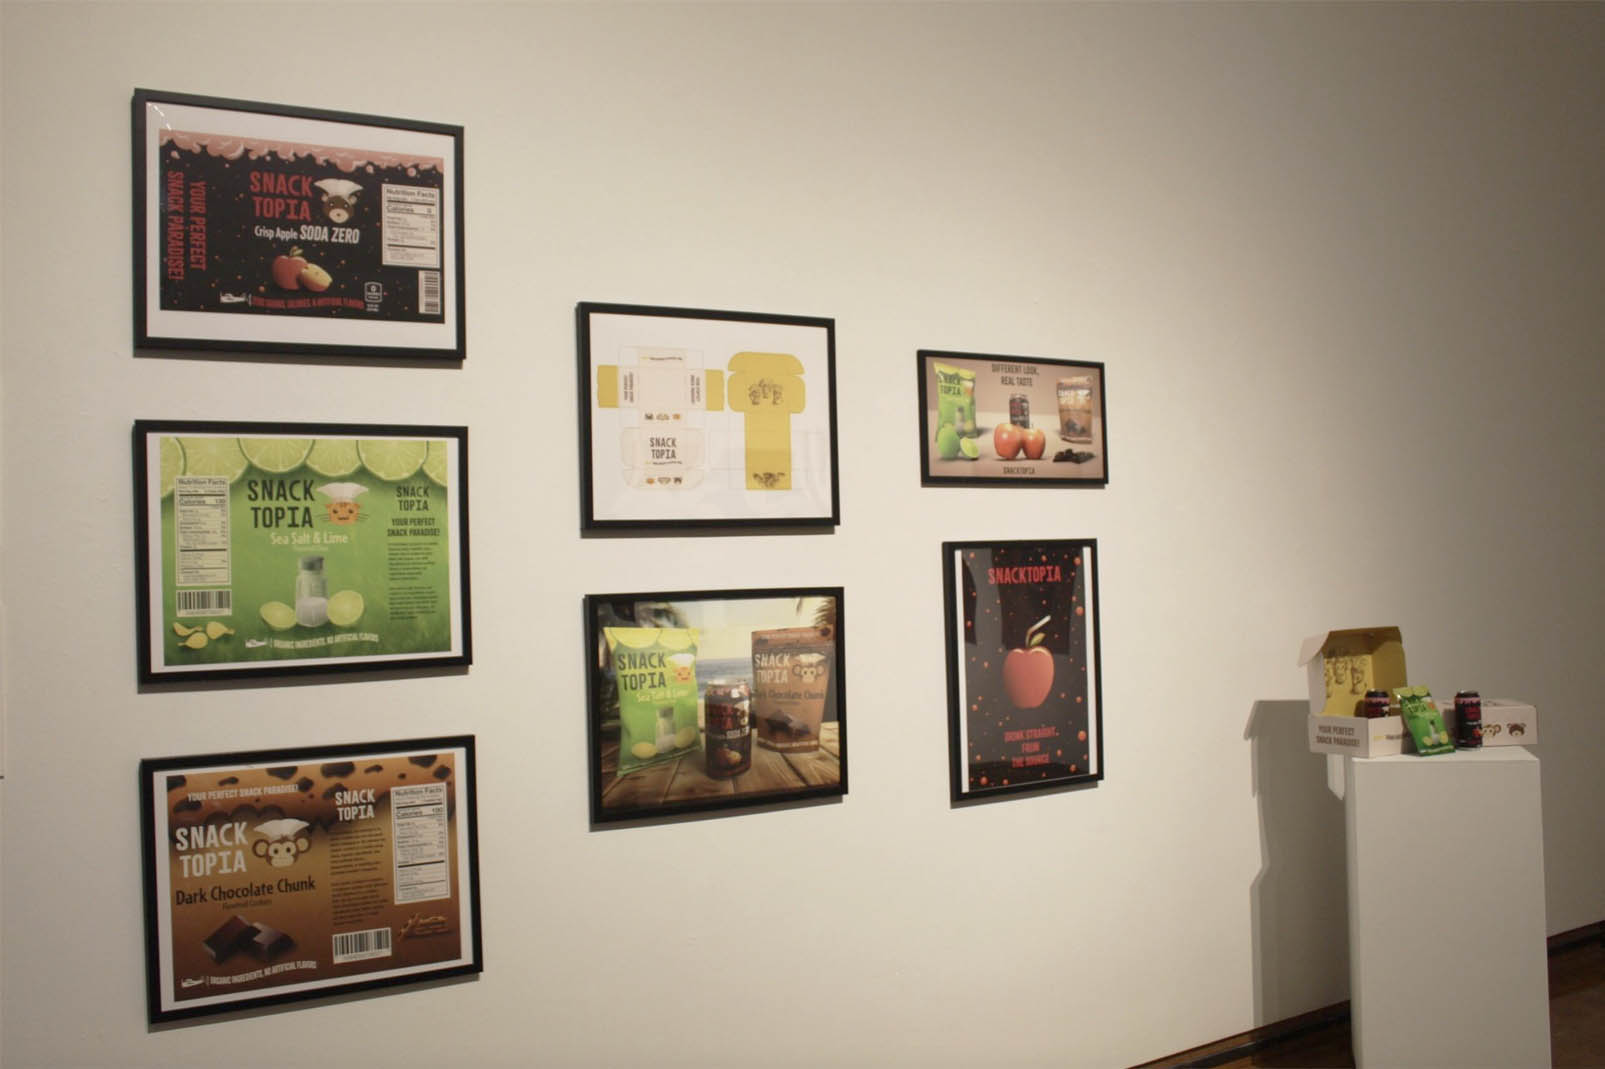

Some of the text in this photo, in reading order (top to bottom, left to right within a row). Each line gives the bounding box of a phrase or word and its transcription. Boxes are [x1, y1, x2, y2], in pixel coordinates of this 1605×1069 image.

[168, 170, 184, 213] SNACK
[250, 171, 313, 198] SNACK
[253, 196, 311, 221] TOPIA
[190, 216, 207, 271] PERFECT
[254, 225, 360, 244] Crisp Apple SODA ZERO
[991, 363, 1022, 374] DIFFERENT
[1000, 376, 1033, 387] REAL TASTE
[649, 437, 677, 448] SNACK
[651, 449, 676, 460] TOPIA
[248, 479, 316, 502] SNACK
[396, 486, 430, 498] SNACK
[398, 500, 429, 511] TOPIA
[250, 506, 314, 529] TOPIA
[391, 518, 435, 526] YOUR PERFECT
[270, 532, 289, 545] Sea
[291, 532, 311, 545] Salt
[323, 531, 349, 544] Lime
[387, 528, 408, 537] SNACK
[987, 565, 1062, 585] SNACKTOPIA
[617, 652, 666, 671] SNACK
[754, 651, 791, 668] SNACK
[621, 672, 666, 692] TOPIA
[756, 669, 788, 684] TOPIA
[1332, 727, 1355, 736] PERFECT
[187, 783, 299, 802] YOUR PERFECT SNACK PARADISE!
[335, 788, 375, 806] SNACK
[337, 805, 374, 821] TOPIA
[175, 821, 249, 851] SNACK
[179, 850, 247, 878] TOPIA
[176, 888, 208, 906] Dark
[210, 882, 274, 901] Chocolate
[276, 876, 317, 894] Chunk
